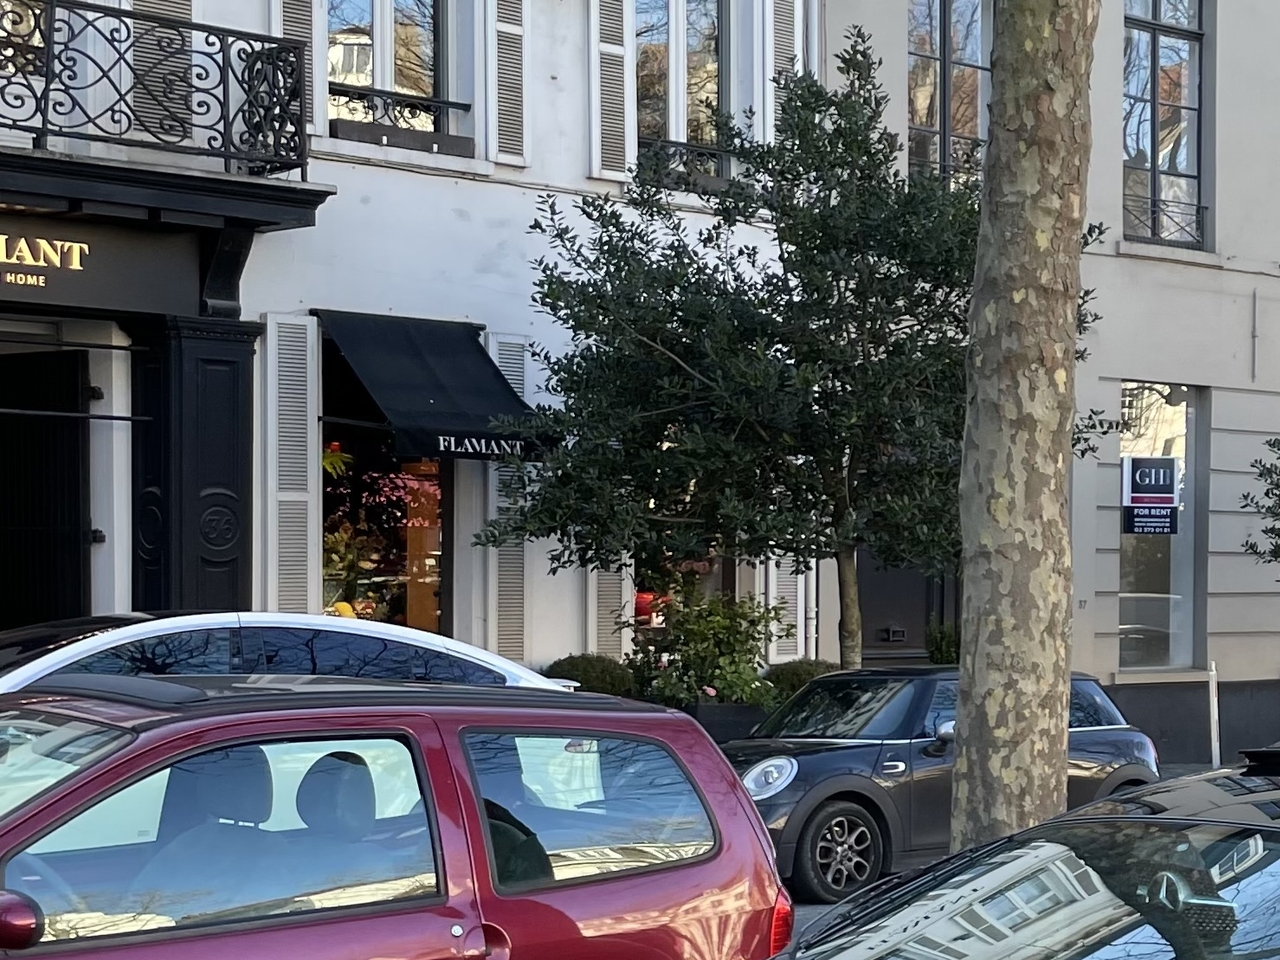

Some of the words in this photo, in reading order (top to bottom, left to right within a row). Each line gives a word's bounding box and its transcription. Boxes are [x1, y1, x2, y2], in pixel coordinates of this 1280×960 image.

[6, 272, 46, 287] HOME
[438, 435, 524, 455] FLAMANT
[1133, 508, 1149, 516] FOR
